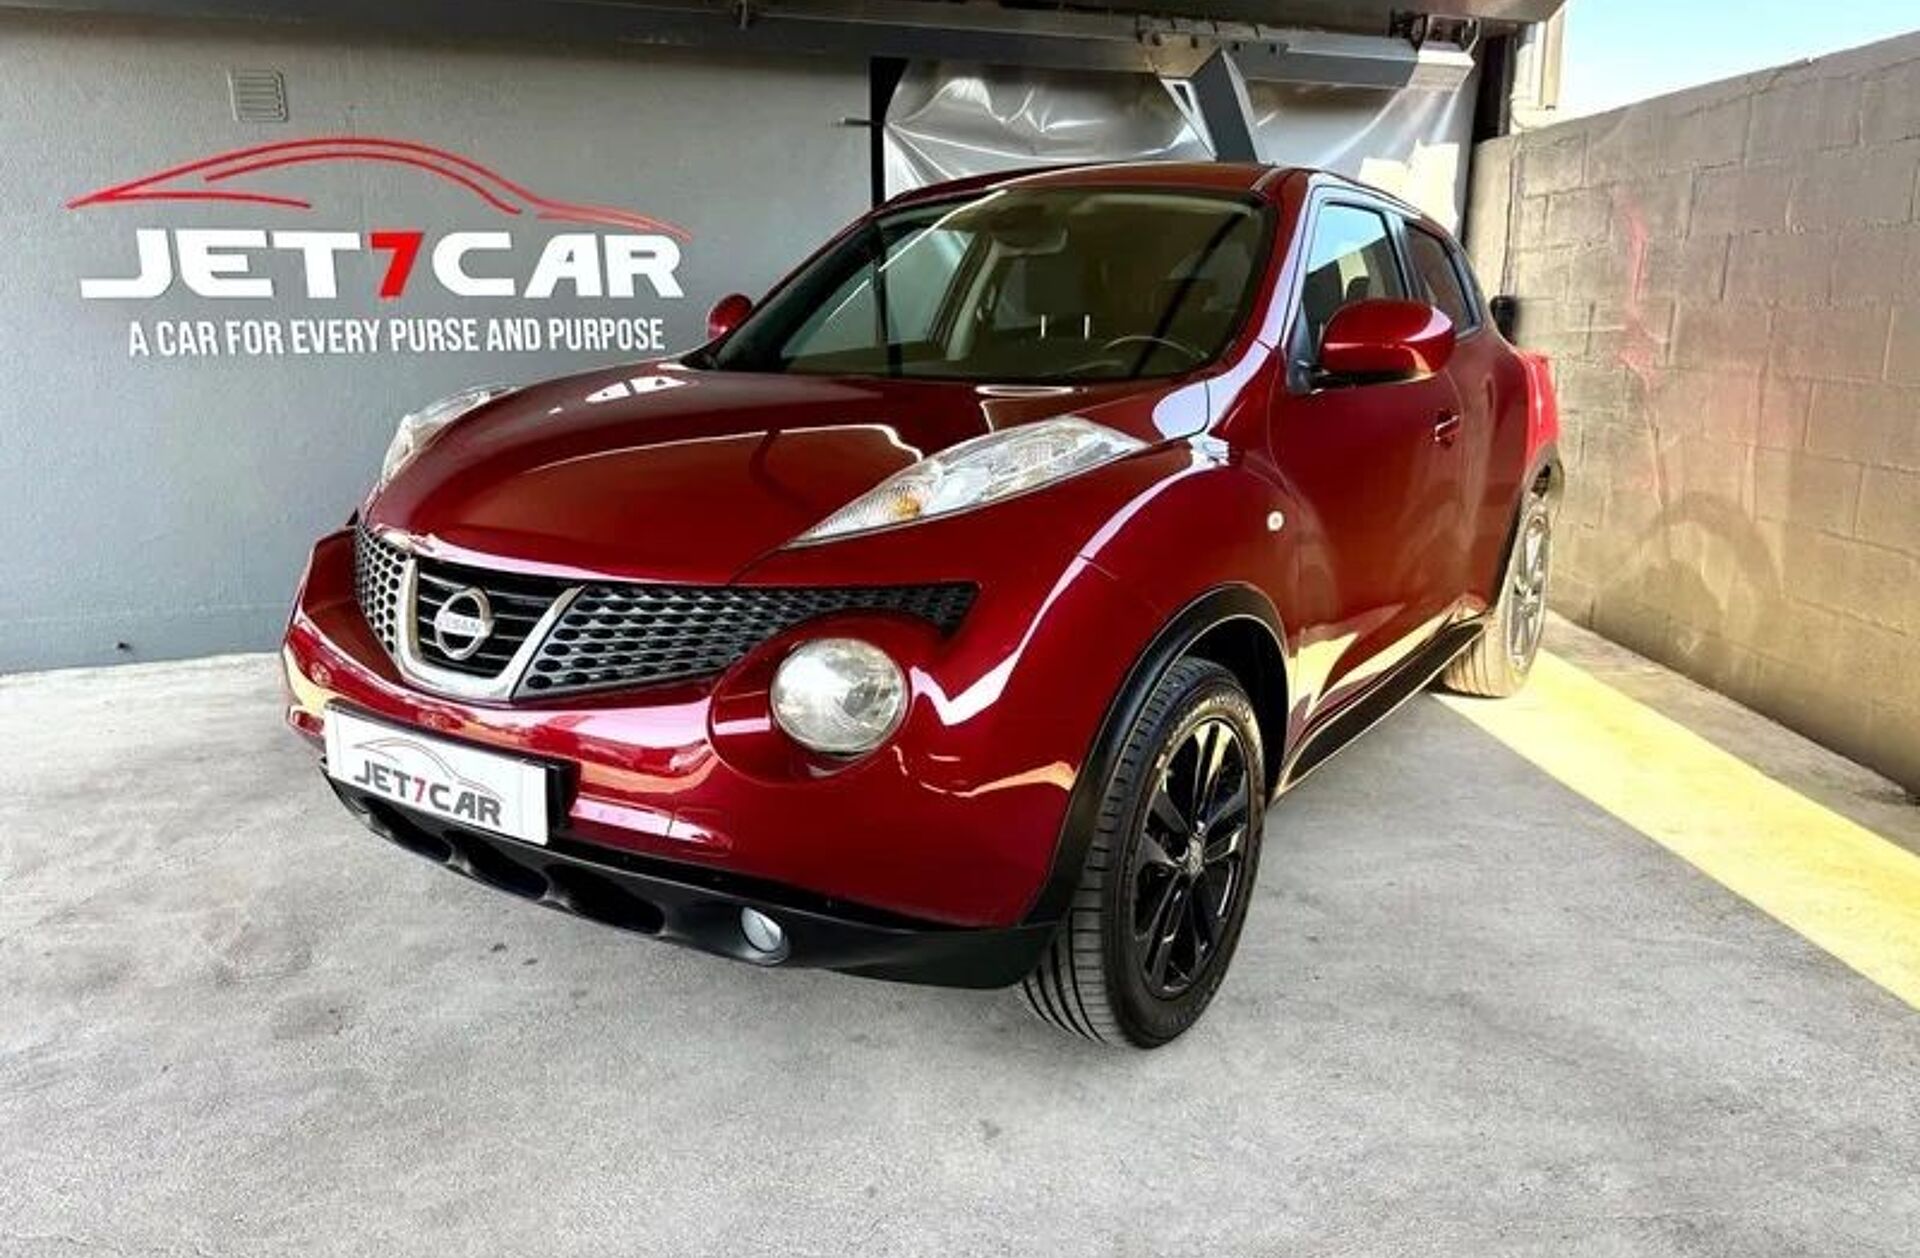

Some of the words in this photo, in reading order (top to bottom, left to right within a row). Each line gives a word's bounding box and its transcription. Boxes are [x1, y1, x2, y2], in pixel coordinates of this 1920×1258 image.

[81, 229, 684, 298] JET7CAR
[129, 321, 149, 356] A
[157, 321, 219, 356] CAR
[225, 320, 284, 355] FOR
[291, 319, 380, 354] EVERY
[389, 318, 479, 351] PURSE
[487, 318, 542, 351] AND
[549, 318, 666, 351] PURPOSE
[354, 760, 502, 826] JET7CAR
